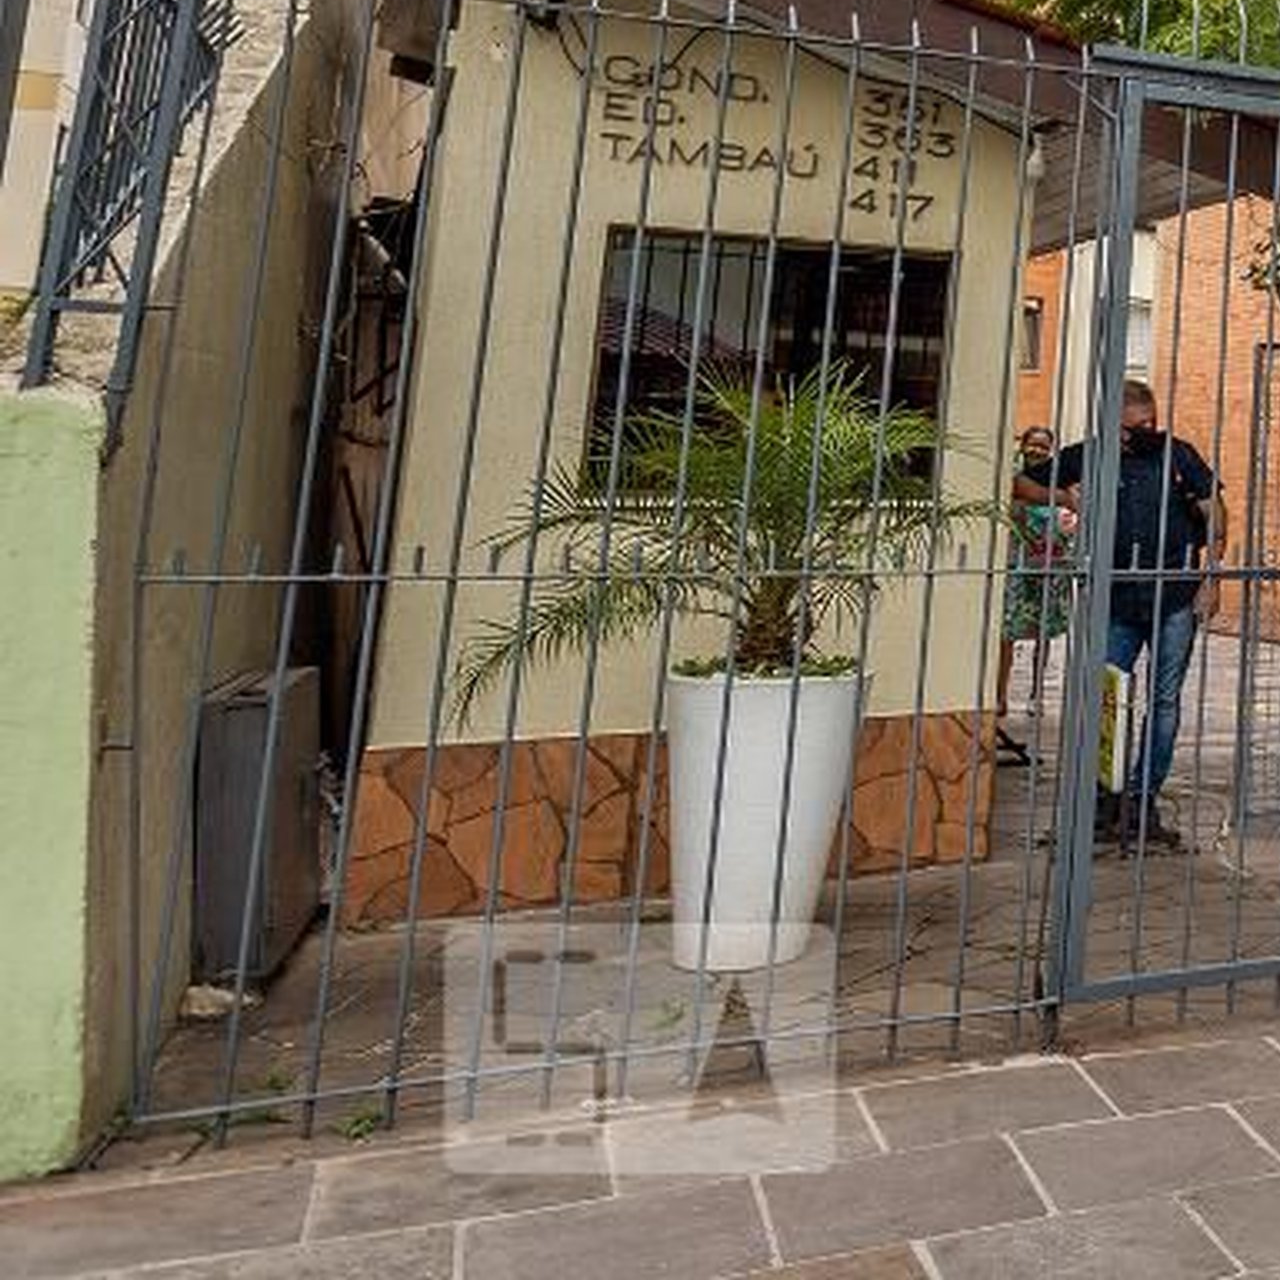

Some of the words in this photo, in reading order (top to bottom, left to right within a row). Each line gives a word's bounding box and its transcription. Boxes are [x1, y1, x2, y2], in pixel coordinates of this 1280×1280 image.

[601, 131, 819, 179] TAMBAÚ
[853, 155, 917, 186] 411
[849, 188, 935, 221] 417
